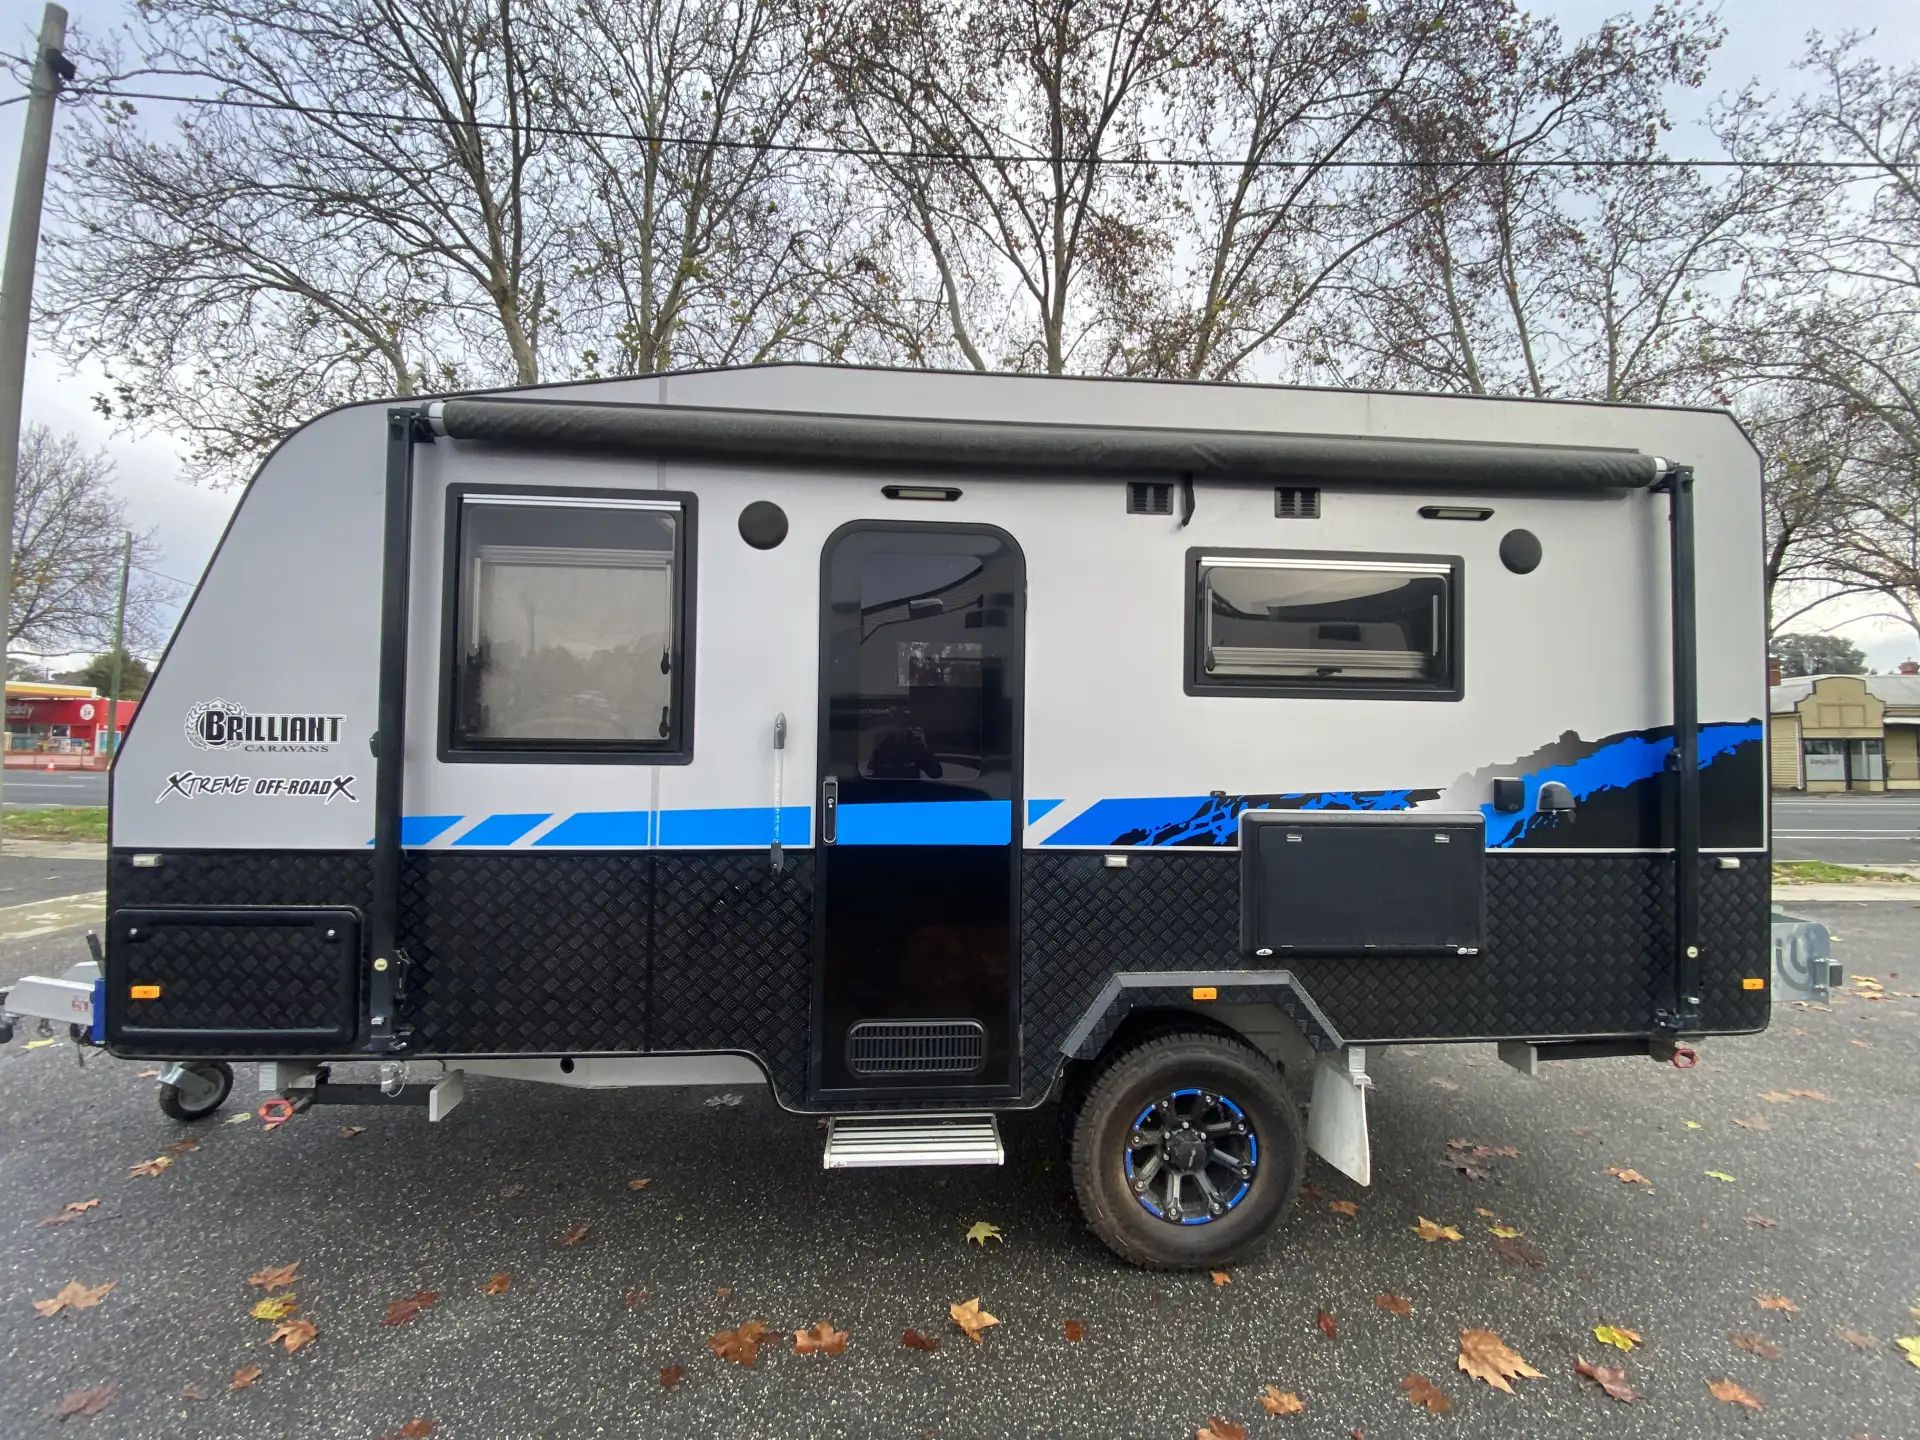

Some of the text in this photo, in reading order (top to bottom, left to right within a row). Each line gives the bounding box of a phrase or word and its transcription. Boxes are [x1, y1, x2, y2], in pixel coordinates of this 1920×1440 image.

[204, 709, 345, 742] BRILLIANT
[244, 744, 329, 753] CARAVANS
[157, 771, 250, 803] XTREME
